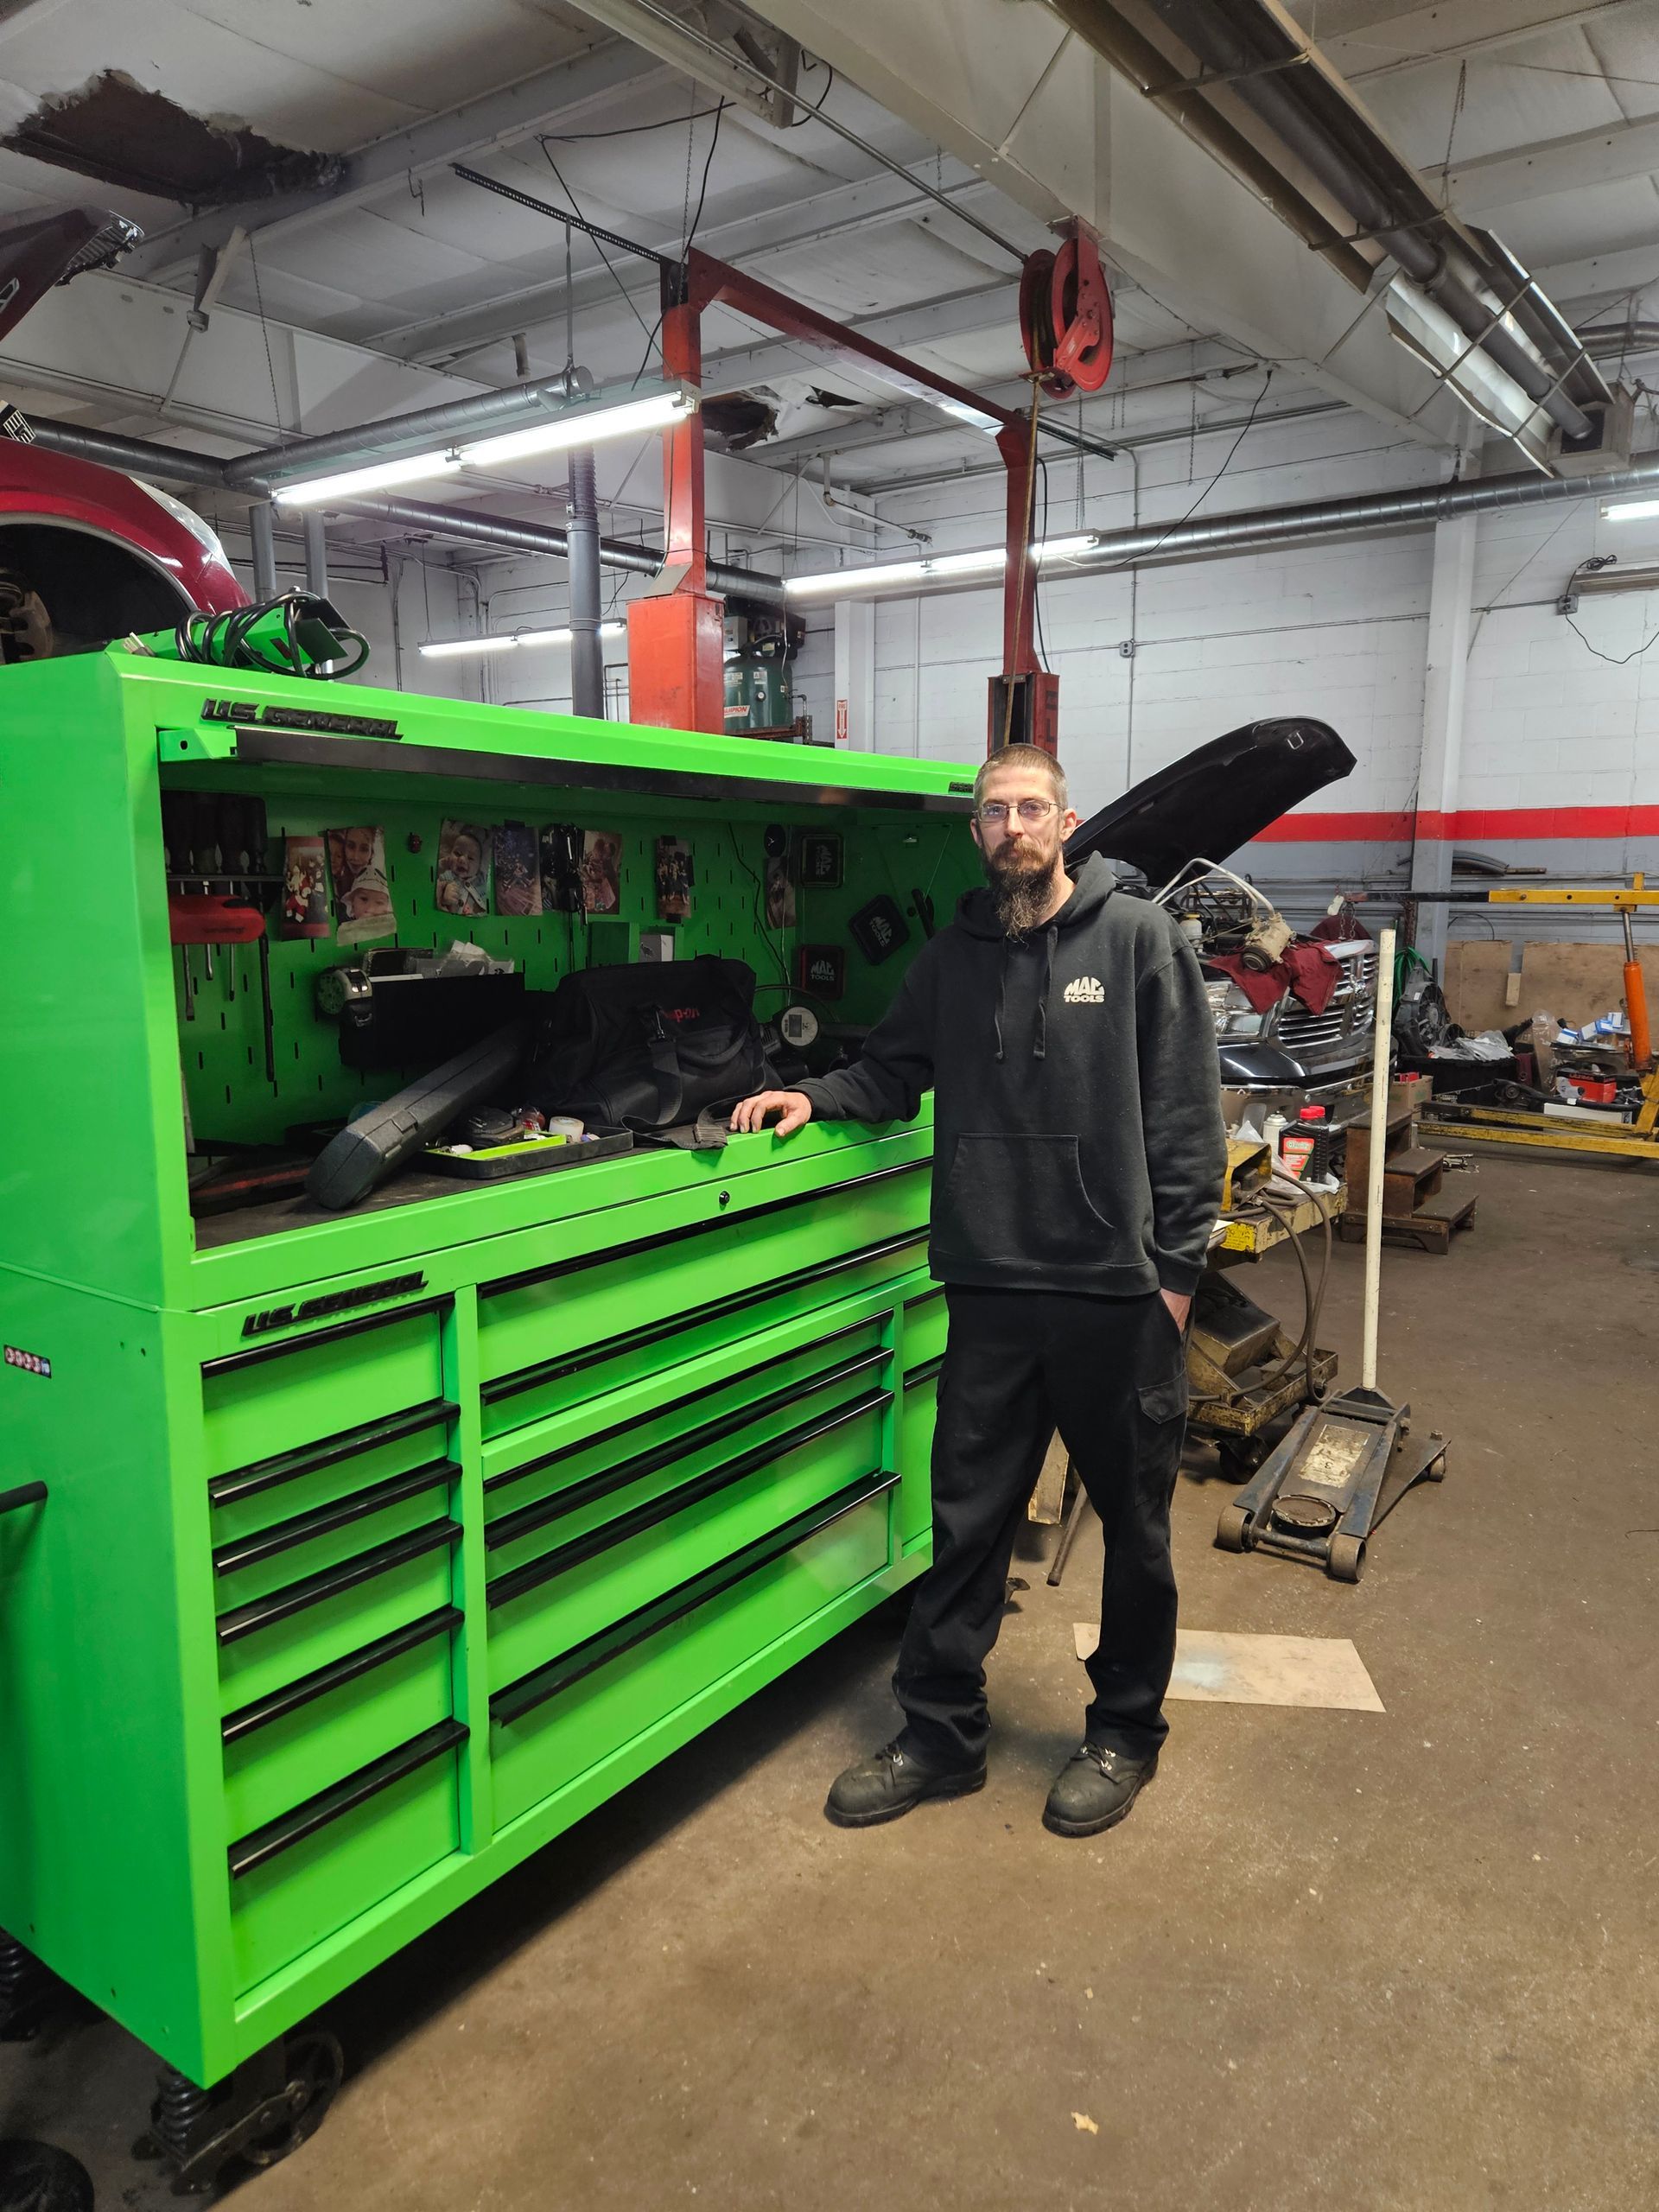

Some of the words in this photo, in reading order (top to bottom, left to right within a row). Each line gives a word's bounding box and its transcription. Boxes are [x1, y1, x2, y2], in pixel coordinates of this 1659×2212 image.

[810, 960, 836, 976] MAC
[1064, 976, 1105, 995] MAC
[1063, 995, 1105, 1003] TOOLS
